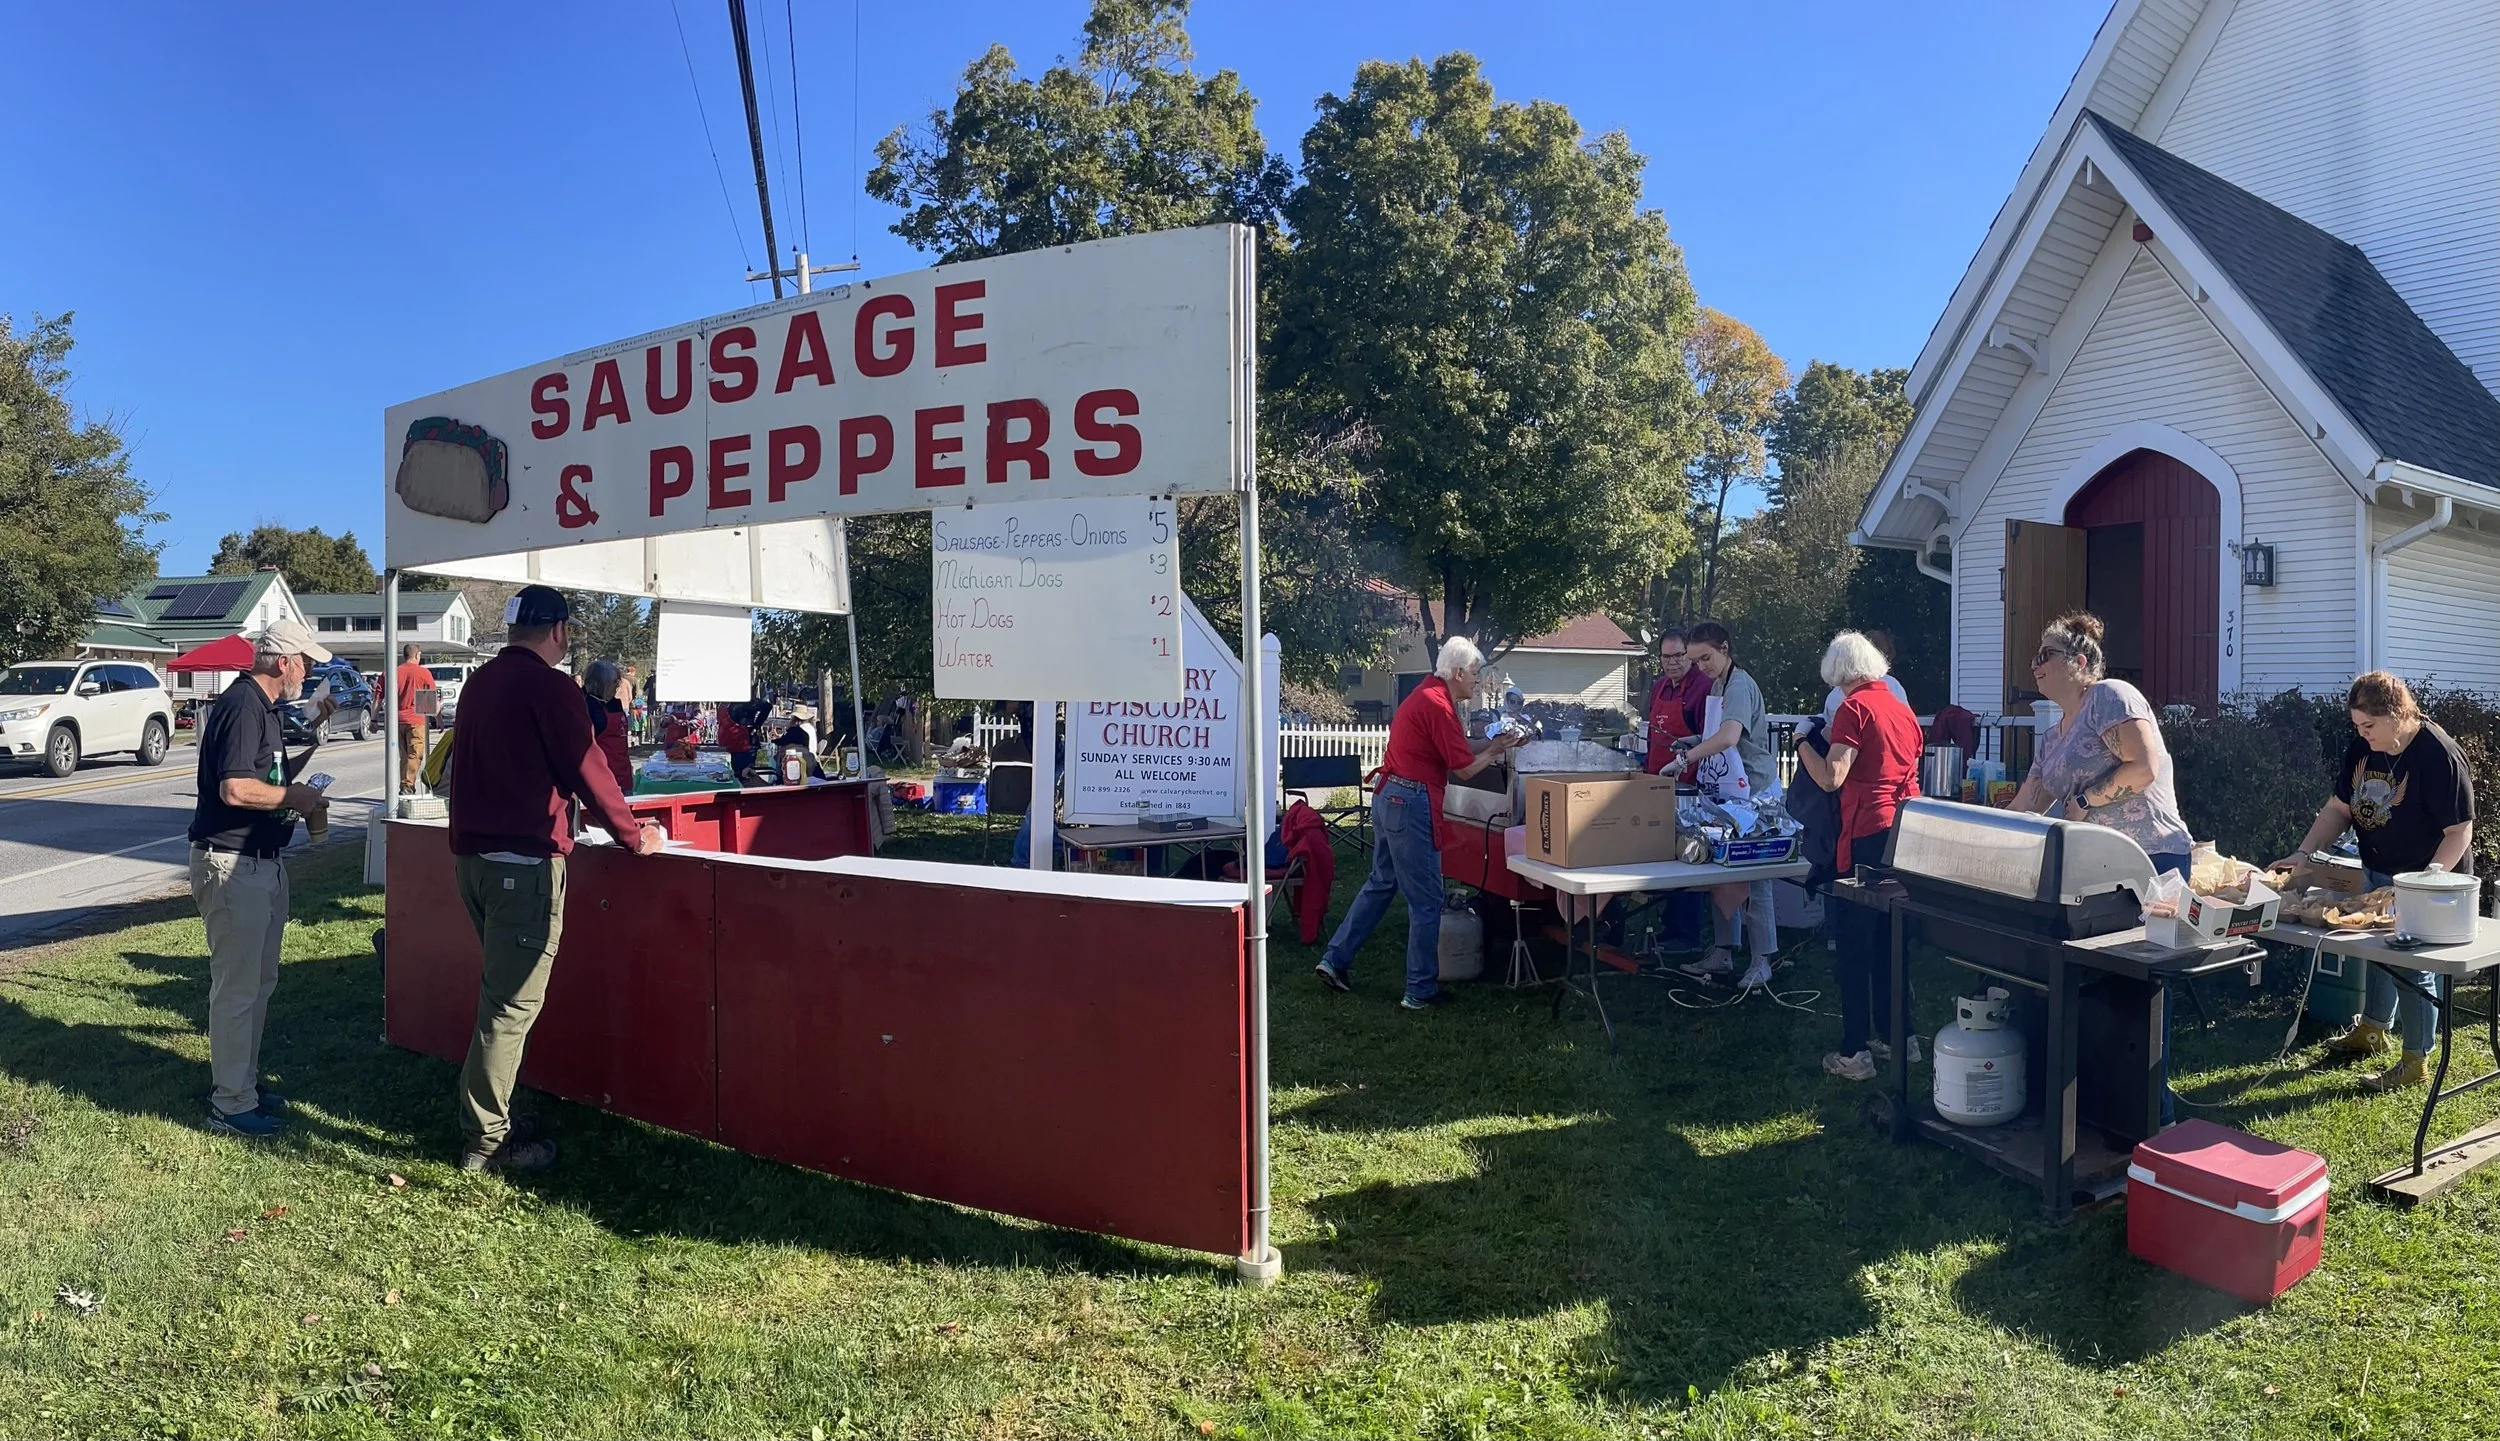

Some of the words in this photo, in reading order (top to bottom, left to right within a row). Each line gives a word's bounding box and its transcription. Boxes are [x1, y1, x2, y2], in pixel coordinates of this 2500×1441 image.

[530, 279, 987, 441] SAUSAGE
[555, 463, 600, 529] &
[650, 388, 1142, 518] PEPPERS
[1150, 553, 1168, 575] $3
[1151, 595, 1172, 617] $2
[2226, 610, 2235, 657] 370
[1152, 637, 1171, 657] $1
[1102, 722, 1211, 749] CHURCH
[1080, 752, 1128, 764] SUNDAY
[1132, 754, 1182, 766] SERVICES
[1187, 756, 1211, 766] 9:30
[1213, 757, 1231, 767] AM
[1114, 769, 1135, 780] ALL
[1141, 770, 1197, 782] WELCOME
[1165, 801, 1173, 809] in
[1175, 802, 1191, 810] 1843
